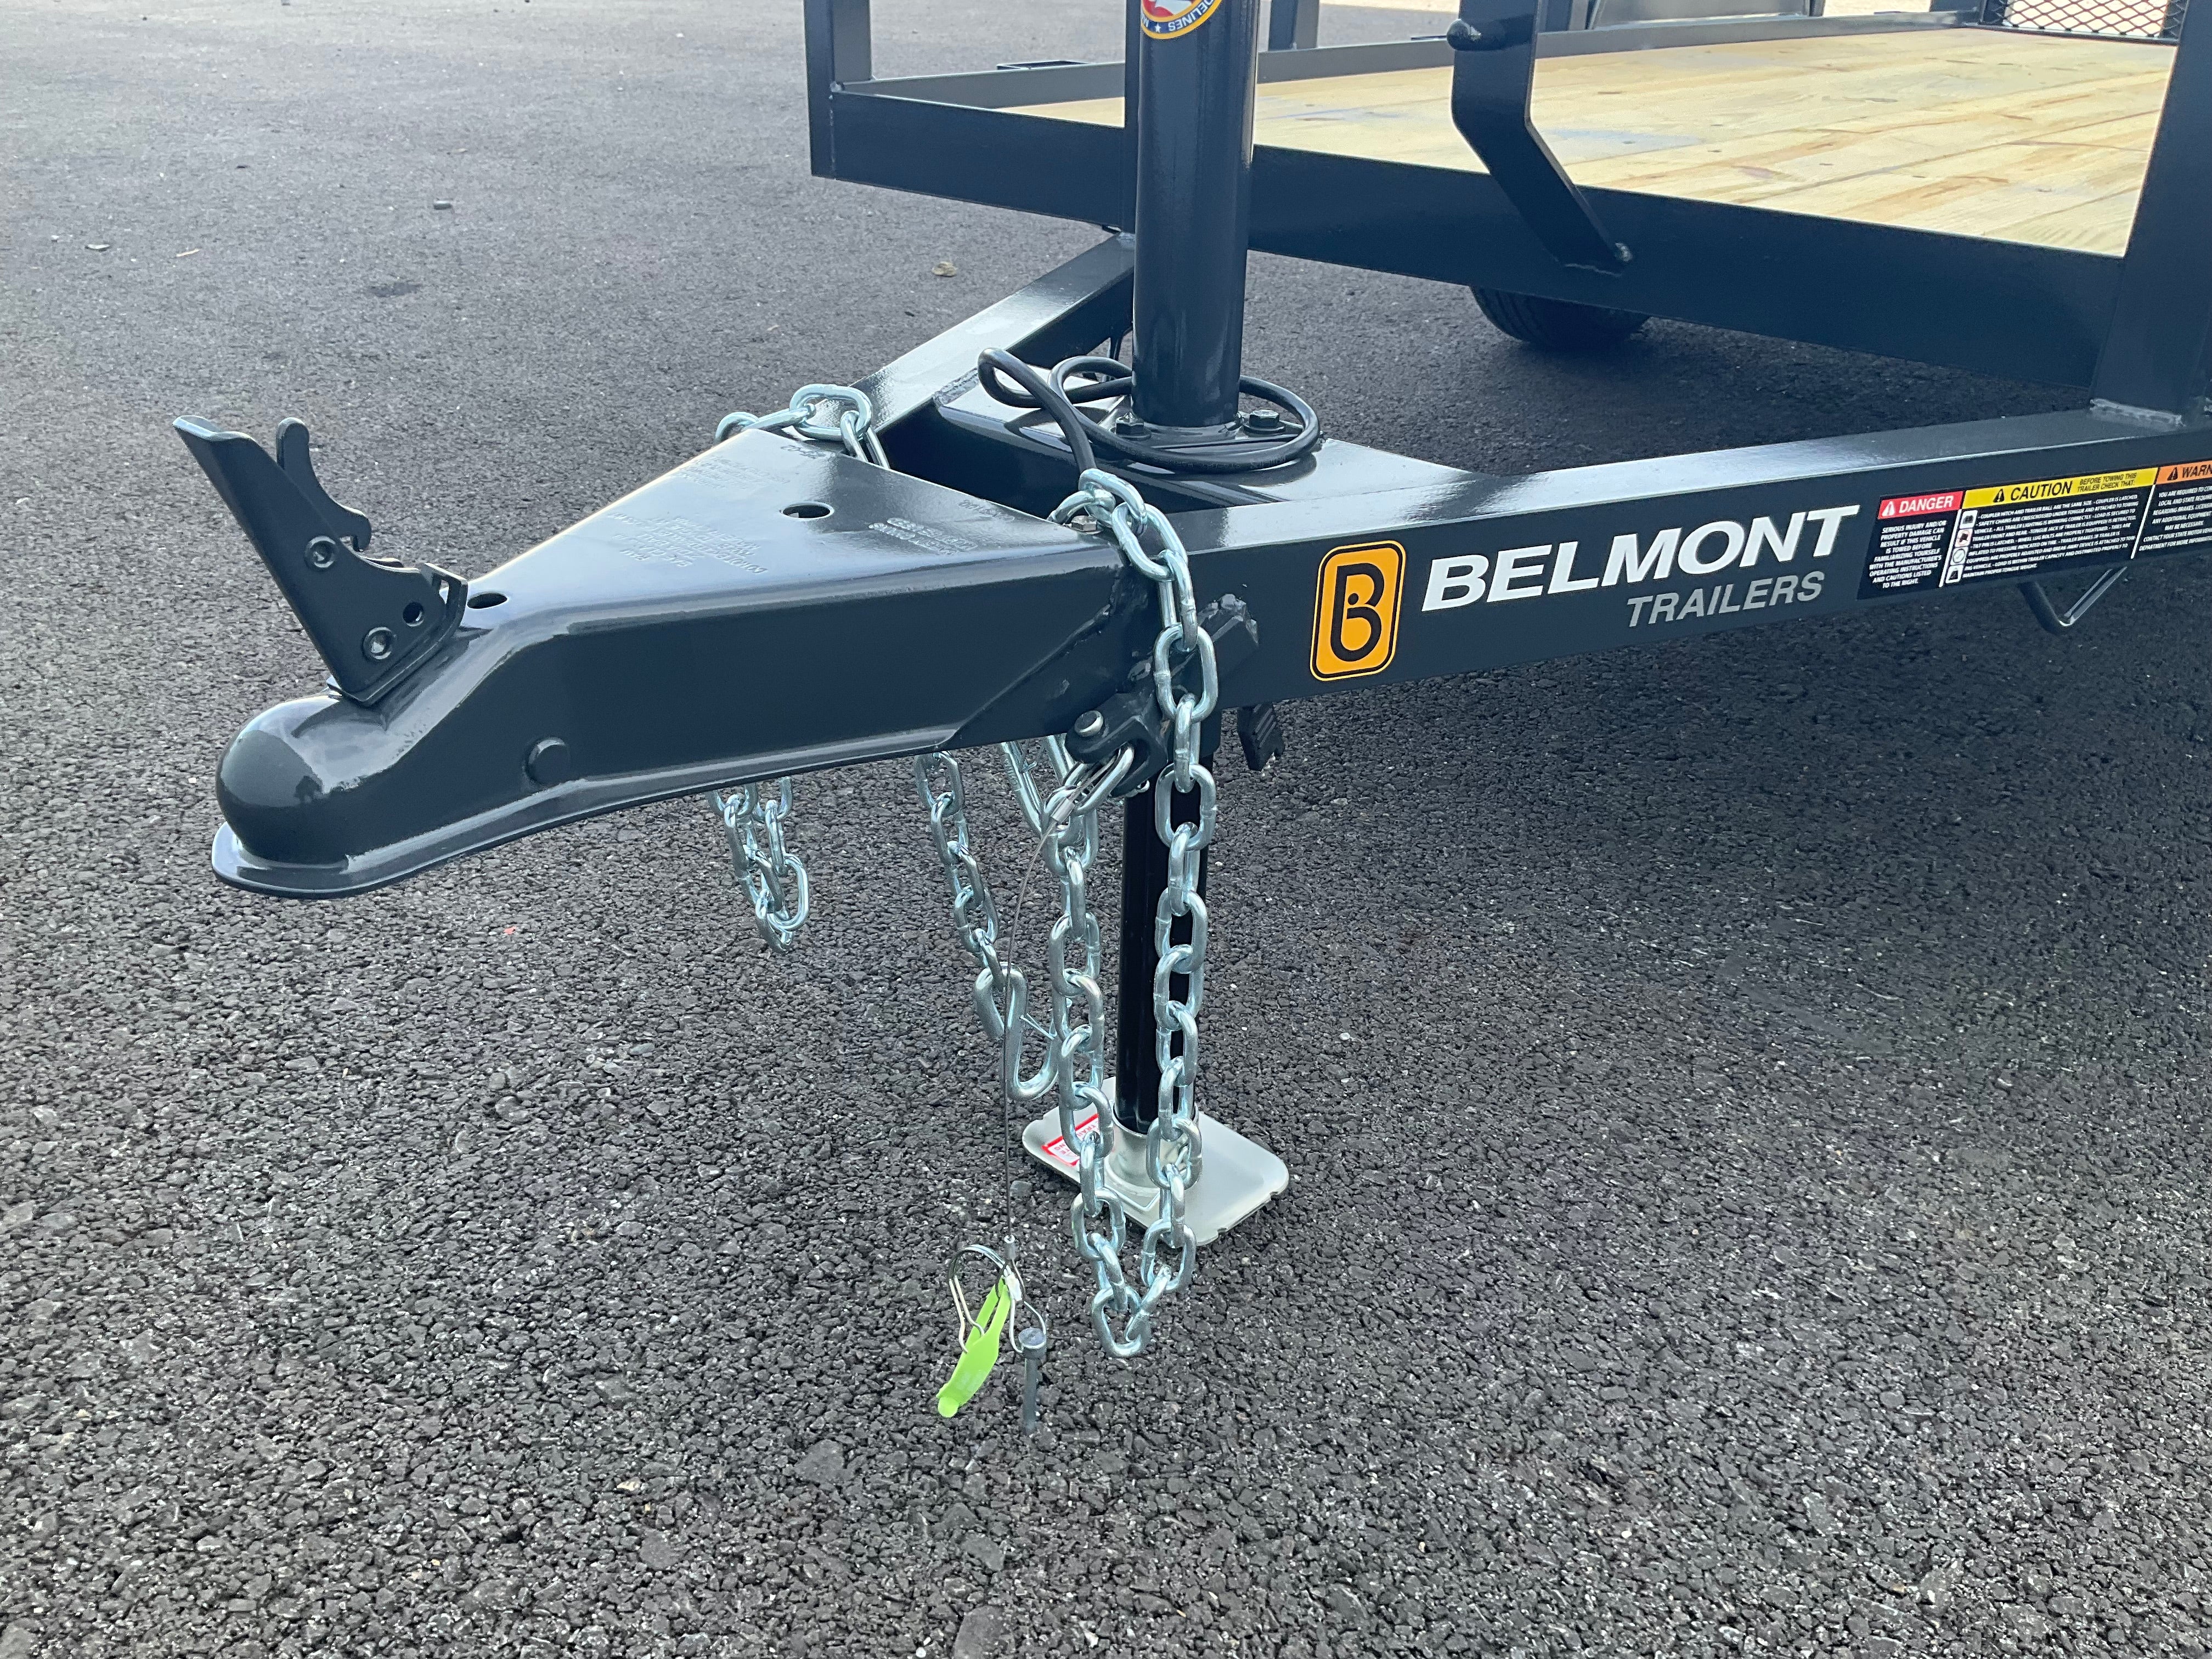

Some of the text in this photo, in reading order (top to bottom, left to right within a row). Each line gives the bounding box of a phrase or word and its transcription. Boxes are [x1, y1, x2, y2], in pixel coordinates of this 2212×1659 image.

[2077, 483, 2100, 493] TRAILER
[2101, 482, 2119, 490] CHECK
[2080, 476, 2102, 486] BEFORE
[2103, 475, 2124, 483] TOWING
[2011, 481, 2073, 501] CAUTION
[1899, 495, 1954, 514] DANGER
[1421, 504, 1860, 612] BELMONT
[1874, 552, 1913, 561] FAMILIARIZING
[1900, 563, 1938, 572] INSTRUCTIONS
[1626, 570, 1825, 628] TRAILERS
